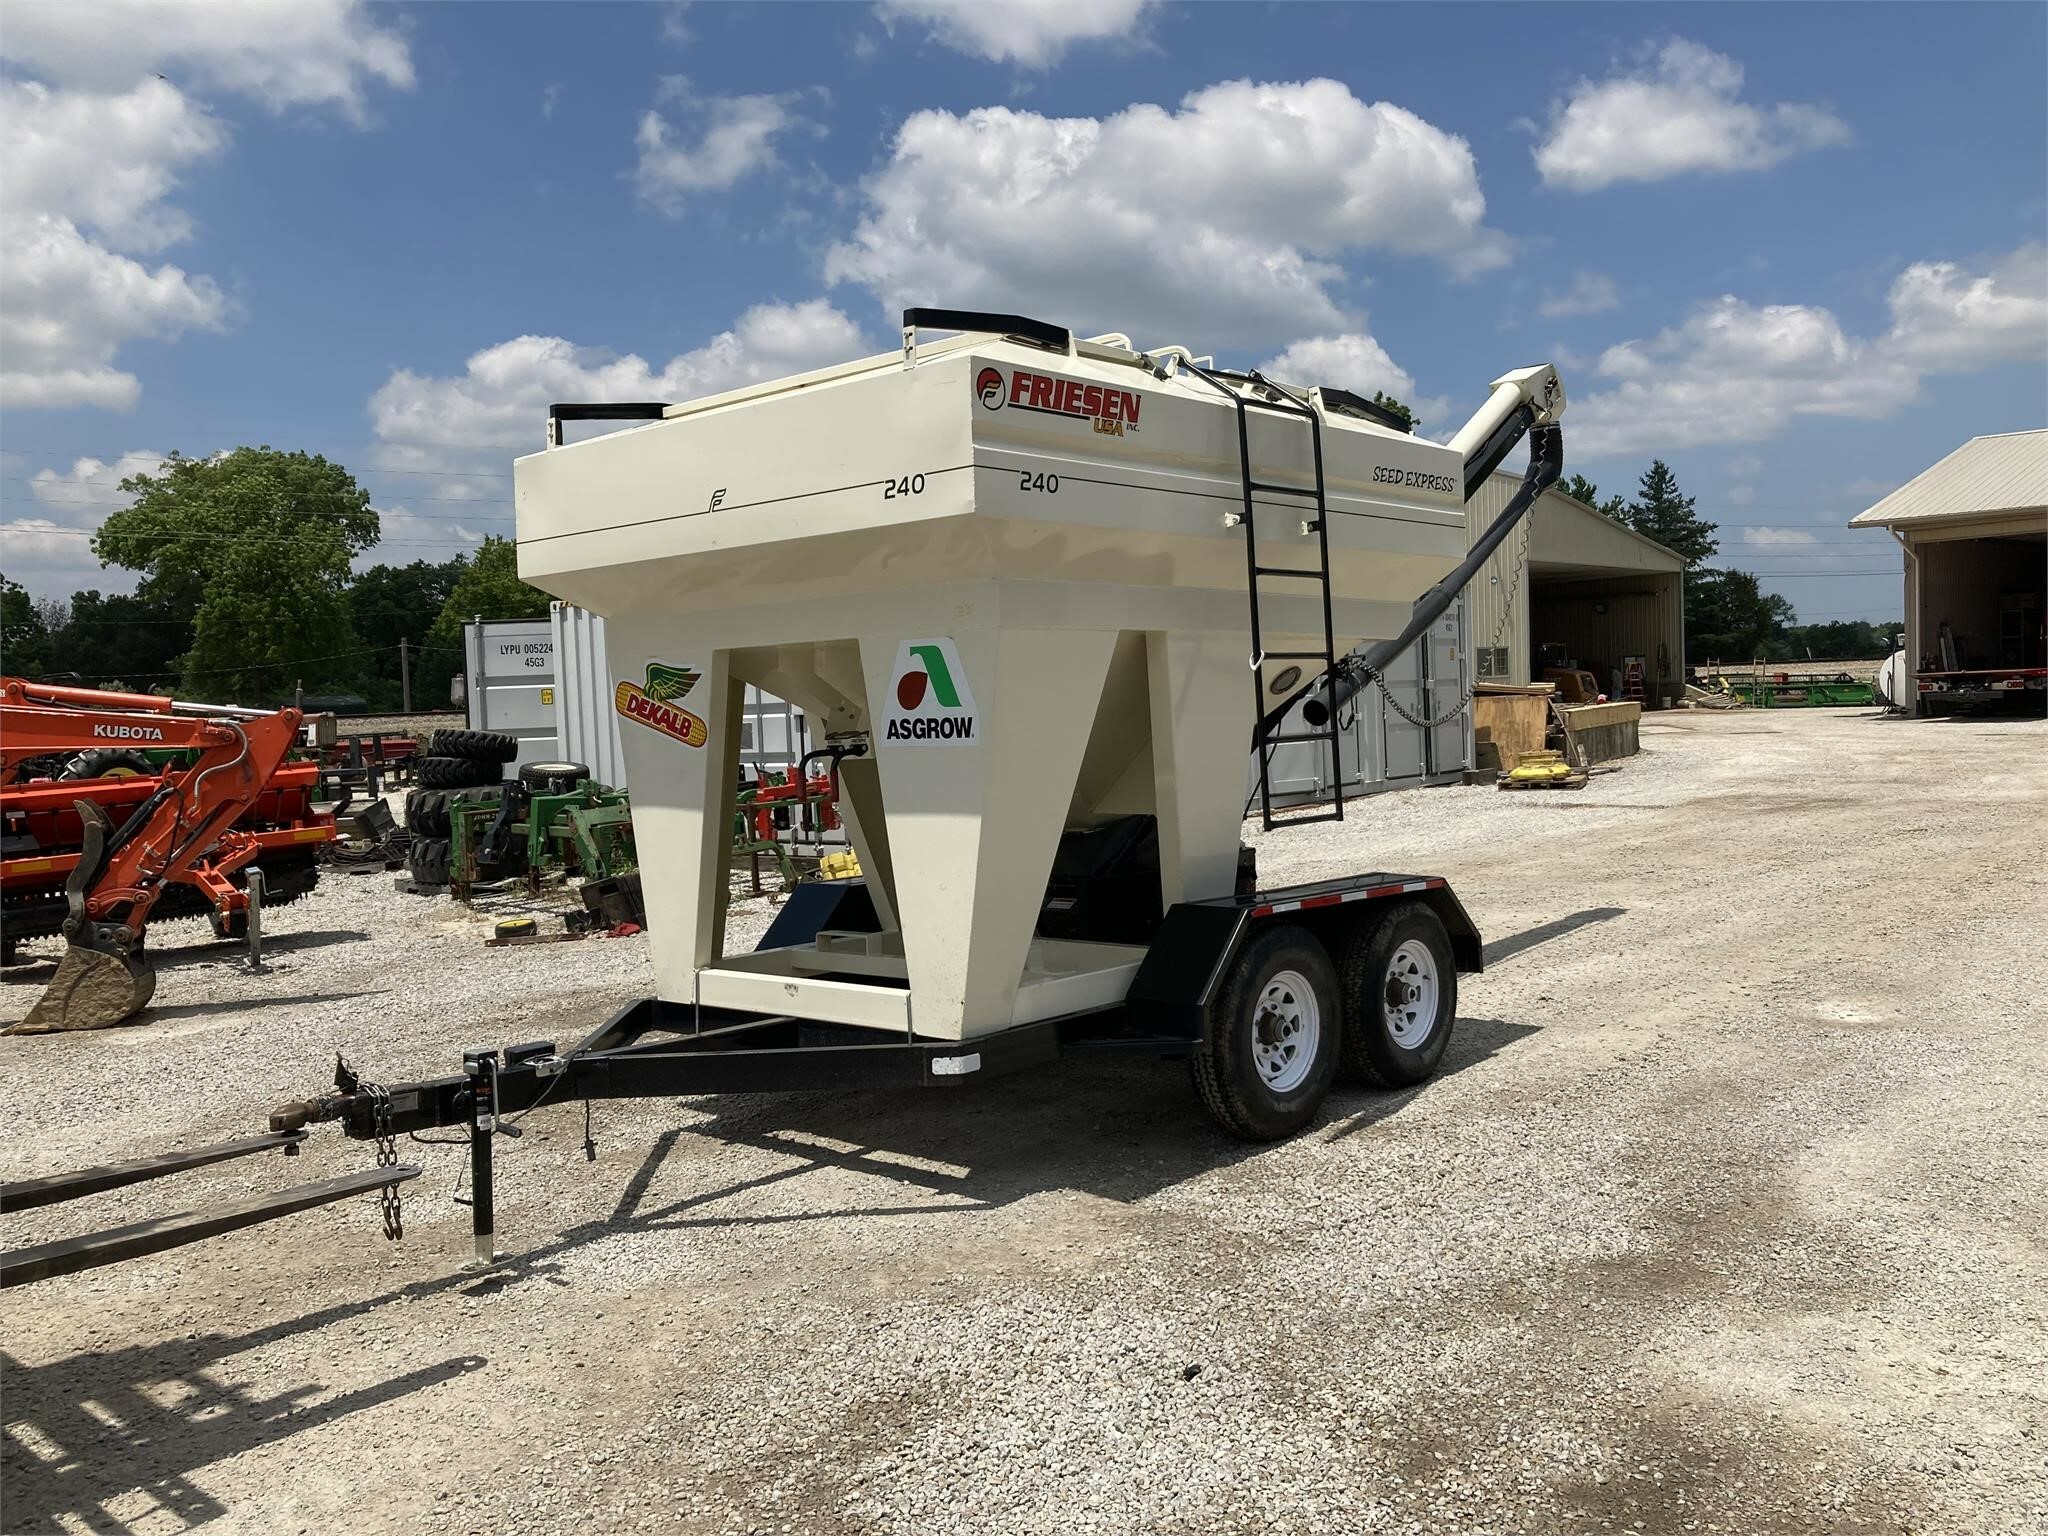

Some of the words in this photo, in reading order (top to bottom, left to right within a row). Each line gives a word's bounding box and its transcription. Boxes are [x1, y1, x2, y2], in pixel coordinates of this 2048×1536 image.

[1009, 371, 1142, 423] FRIESEN
[1093, 418, 1124, 437] USA
[884, 473, 925, 500] 240
[1020, 470, 1059, 493] 240
[1372, 465, 1404, 485] SEED
[1405, 471, 1455, 492] EXPRESS
[500, 644, 520, 655] LYPU
[524, 643, 553, 654] 005224
[525, 657, 545, 668] 45G3
[625, 692, 693, 739] DEKALB
[93, 724, 163, 741] KUBOTA
[886, 716, 973, 740] ASGROW
